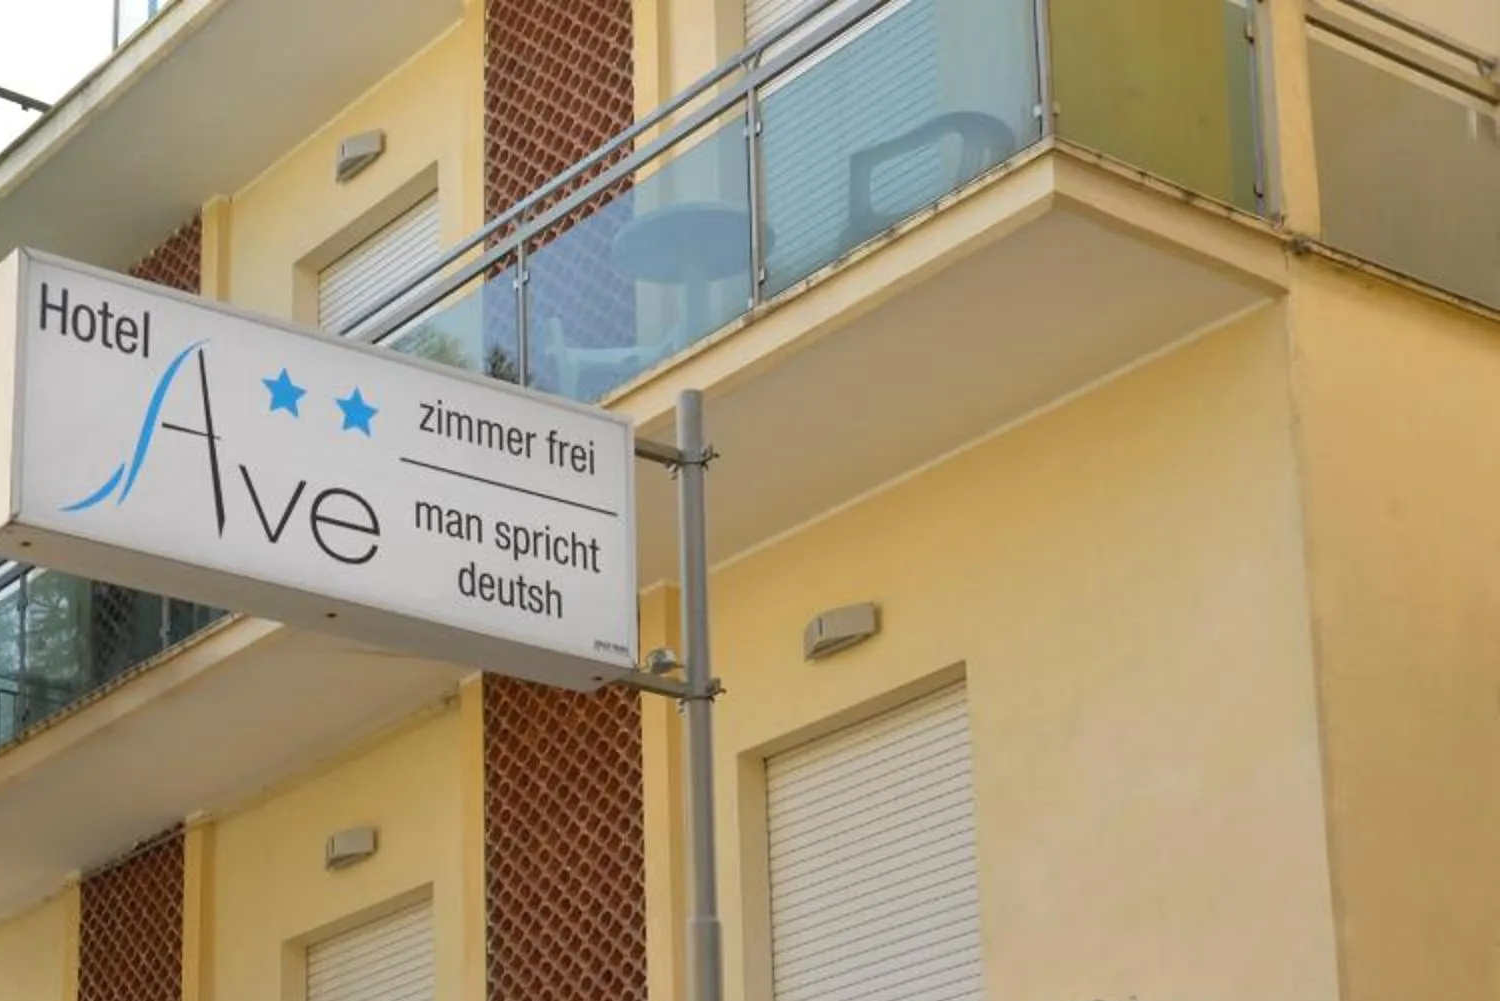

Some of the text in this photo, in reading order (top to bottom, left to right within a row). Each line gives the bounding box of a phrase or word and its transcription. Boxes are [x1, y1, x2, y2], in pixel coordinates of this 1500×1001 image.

[38, 282, 151, 359] Hotel
[60, 338, 382, 566] Ave
[418, 402, 596, 476] zimmer frei
[414, 500, 601, 574] man spricht
[457, 561, 564, 619] deutsh
